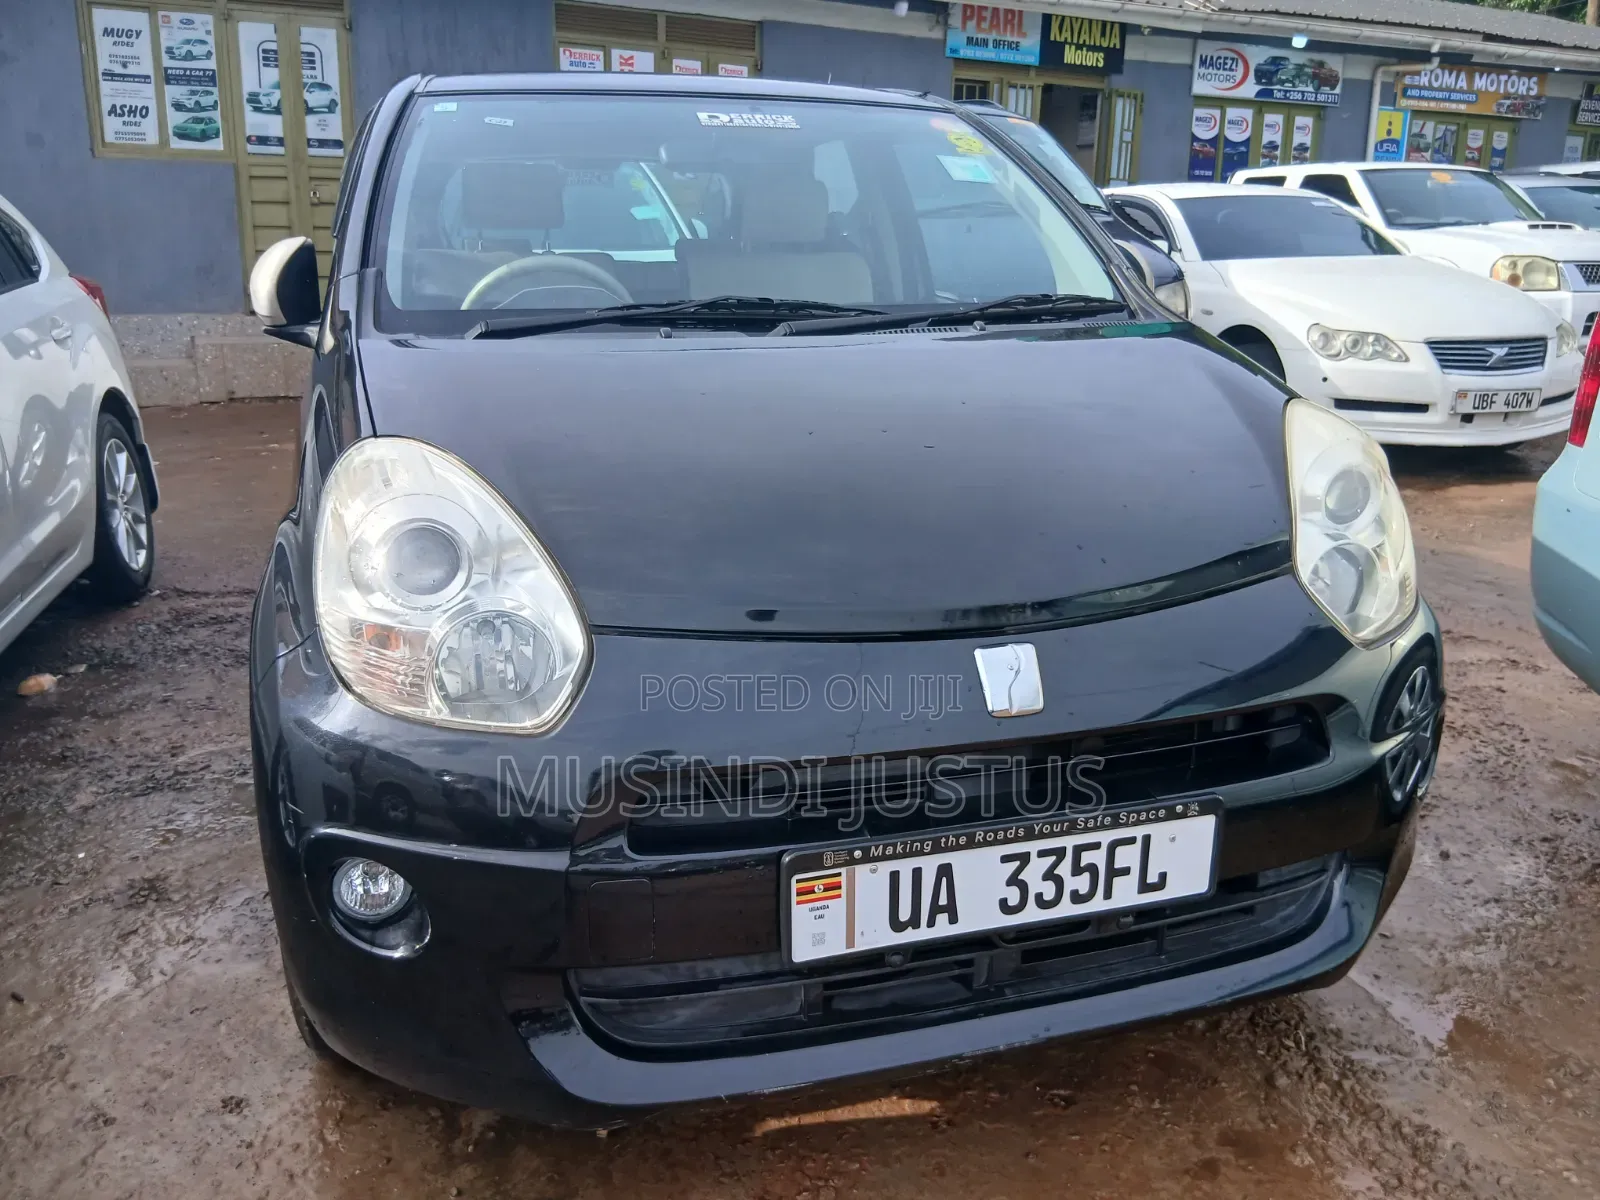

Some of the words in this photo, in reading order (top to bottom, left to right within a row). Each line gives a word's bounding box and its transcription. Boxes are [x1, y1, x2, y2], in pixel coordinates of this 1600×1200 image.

[961, 4, 1027, 38] PEARL
[102, 27, 142, 39] MUGY
[1051, 14, 1120, 49] KAYANJA
[112, 40, 135, 48] RIDES
[966, 36, 989, 48] MAIN
[992, 38, 1020, 51] OFFICE
[1064, 44, 1104, 67] Motors
[569, 60, 587, 68] auto
[1197, 72, 1237, 84] MOTORS
[1420, 68, 1468, 91] ROMA
[1474, 72, 1539, 96] MOTORS
[1273, 89, 1285, 98] Tel:
[1303, 92, 1316, 100] 702
[1406, 89, 1420, 97] AND
[1420, 90, 1450, 99] PROPERTY
[1450, 92, 1476, 101] SERVICES
[107, 103, 149, 119] ASHO
[1377, 143, 1398, 152] URA
[1472, 393, 1499, 410] UBF
[1504, 391, 1535, 409] 407W
[870, 841, 933, 858] Making
[941, 834, 967, 848] the
[975, 826, 1025, 843] Roads
[1033, 821, 1069, 835] Your
[1077, 814, 1111, 829] Safe
[1119, 808, 1166, 824] Space
[888, 862, 959, 934] UA
[998, 833, 1168, 917] 335FL
[808, 904, 830, 912] UGANDA
